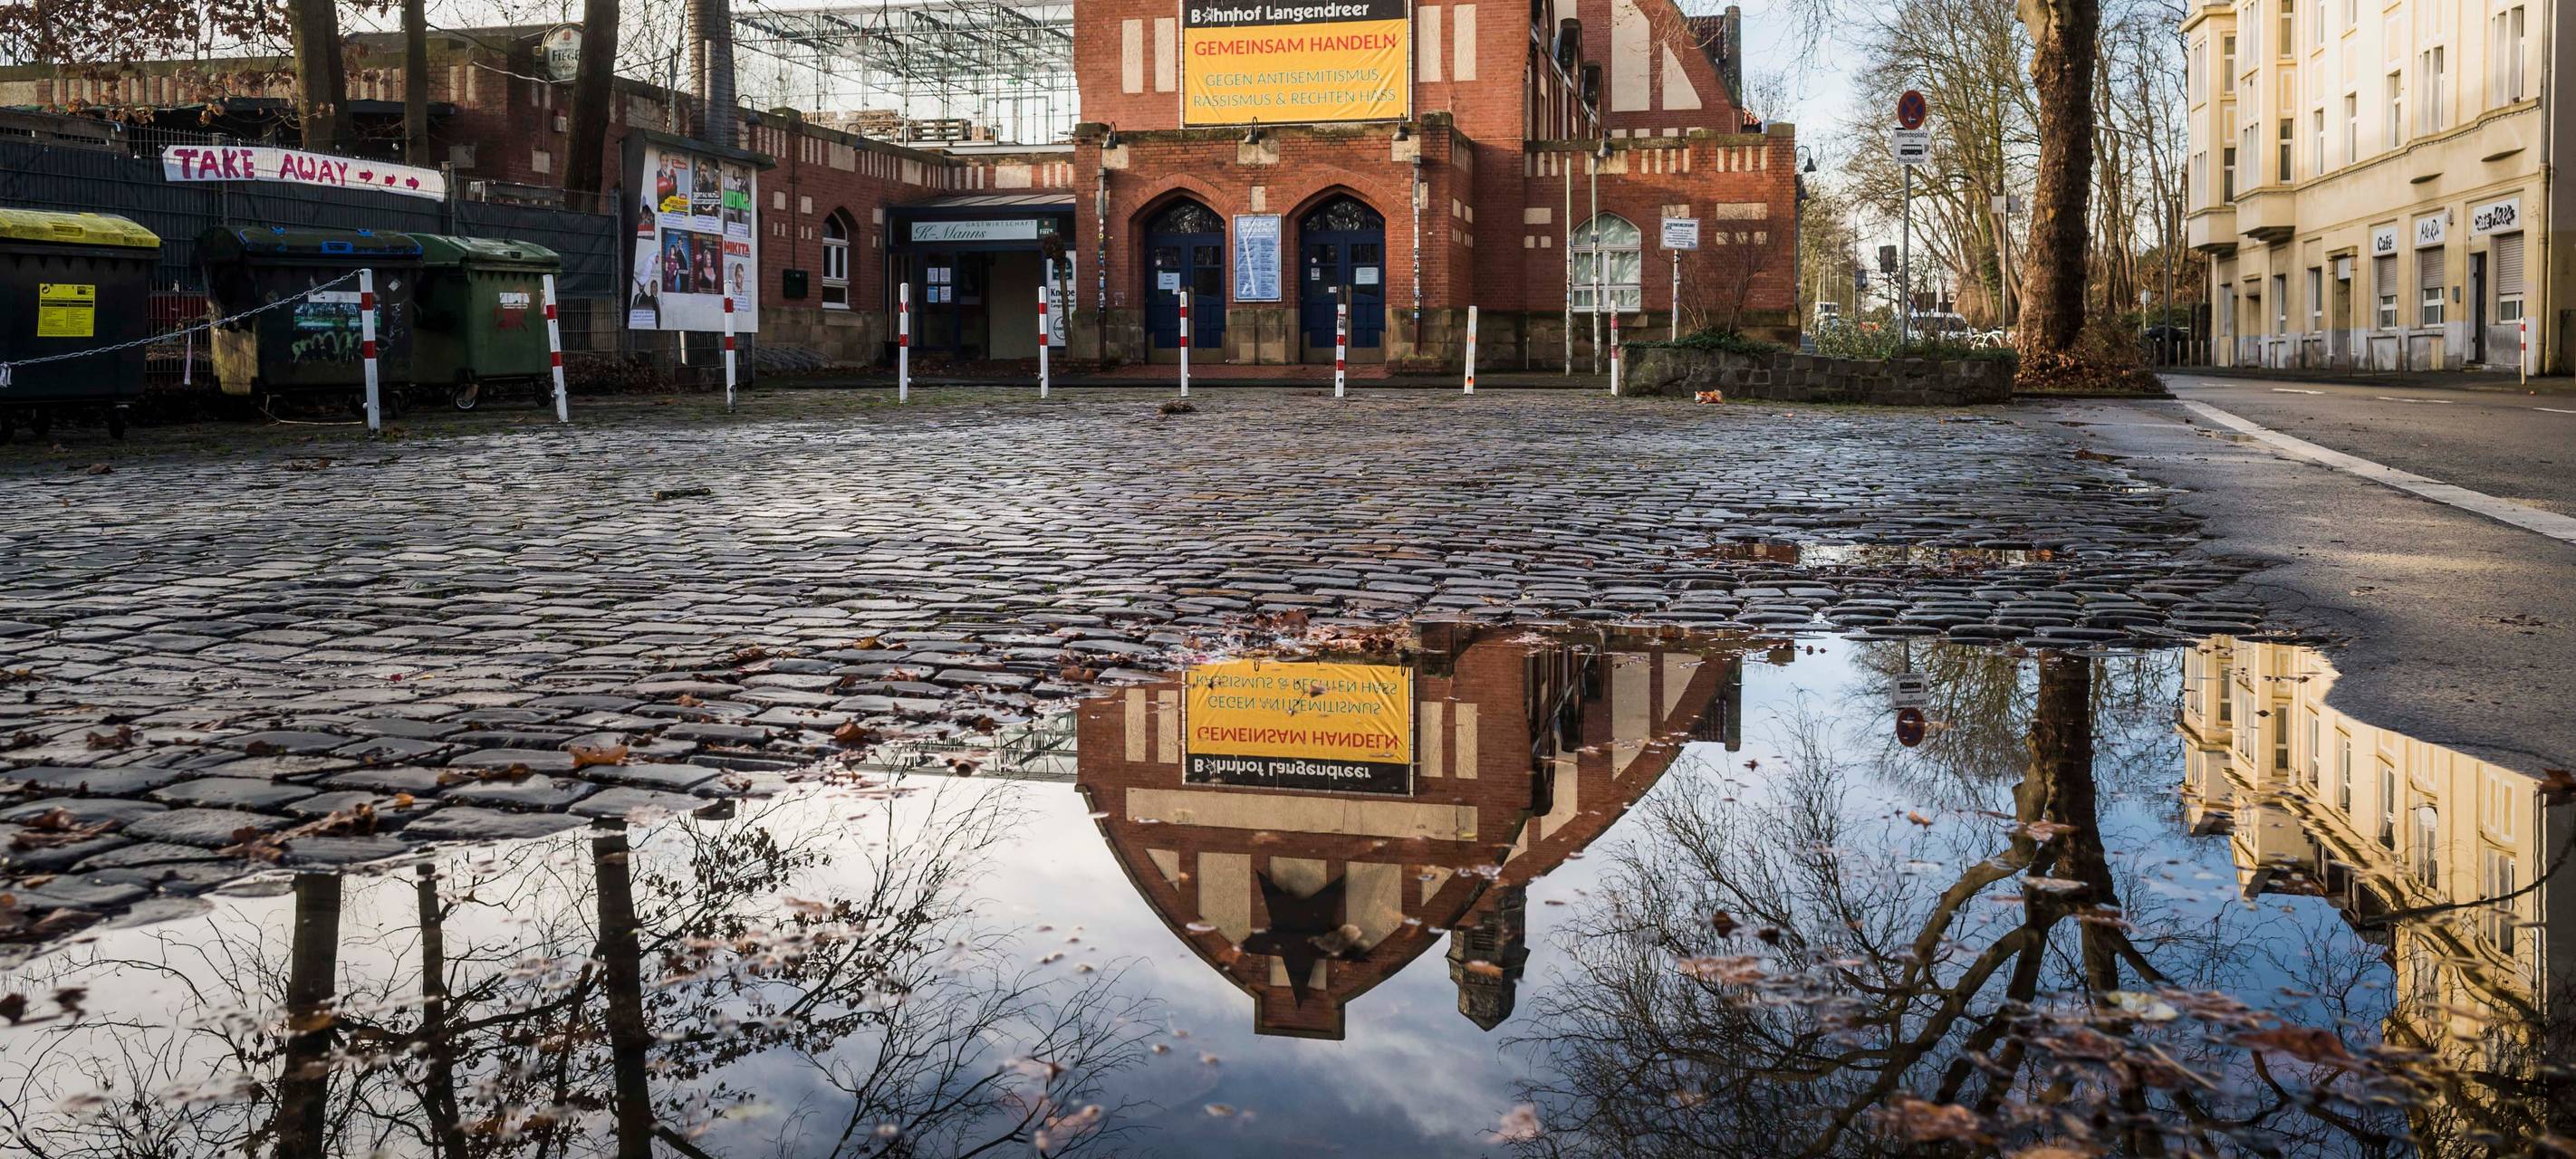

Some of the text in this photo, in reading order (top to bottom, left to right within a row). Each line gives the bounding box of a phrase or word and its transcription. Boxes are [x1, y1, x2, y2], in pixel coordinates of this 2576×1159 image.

[1266, 4, 1369, 24] Langendreer
[1195, 34, 1396, 56] GEMEINSAM HANDELN
[1206, 68, 1383, 87] GEGEN ANTISEMITISMUS,
[1194, 89, 1396, 108] RASSISMUS & RECHTEN HASS
[1897, 130, 1928, 139] Wendeplatz
[173, 148, 349, 187] TAKE AWAY
[913, 224, 987, 240] K-Manns
[2378, 234, 2392, 252] Café
